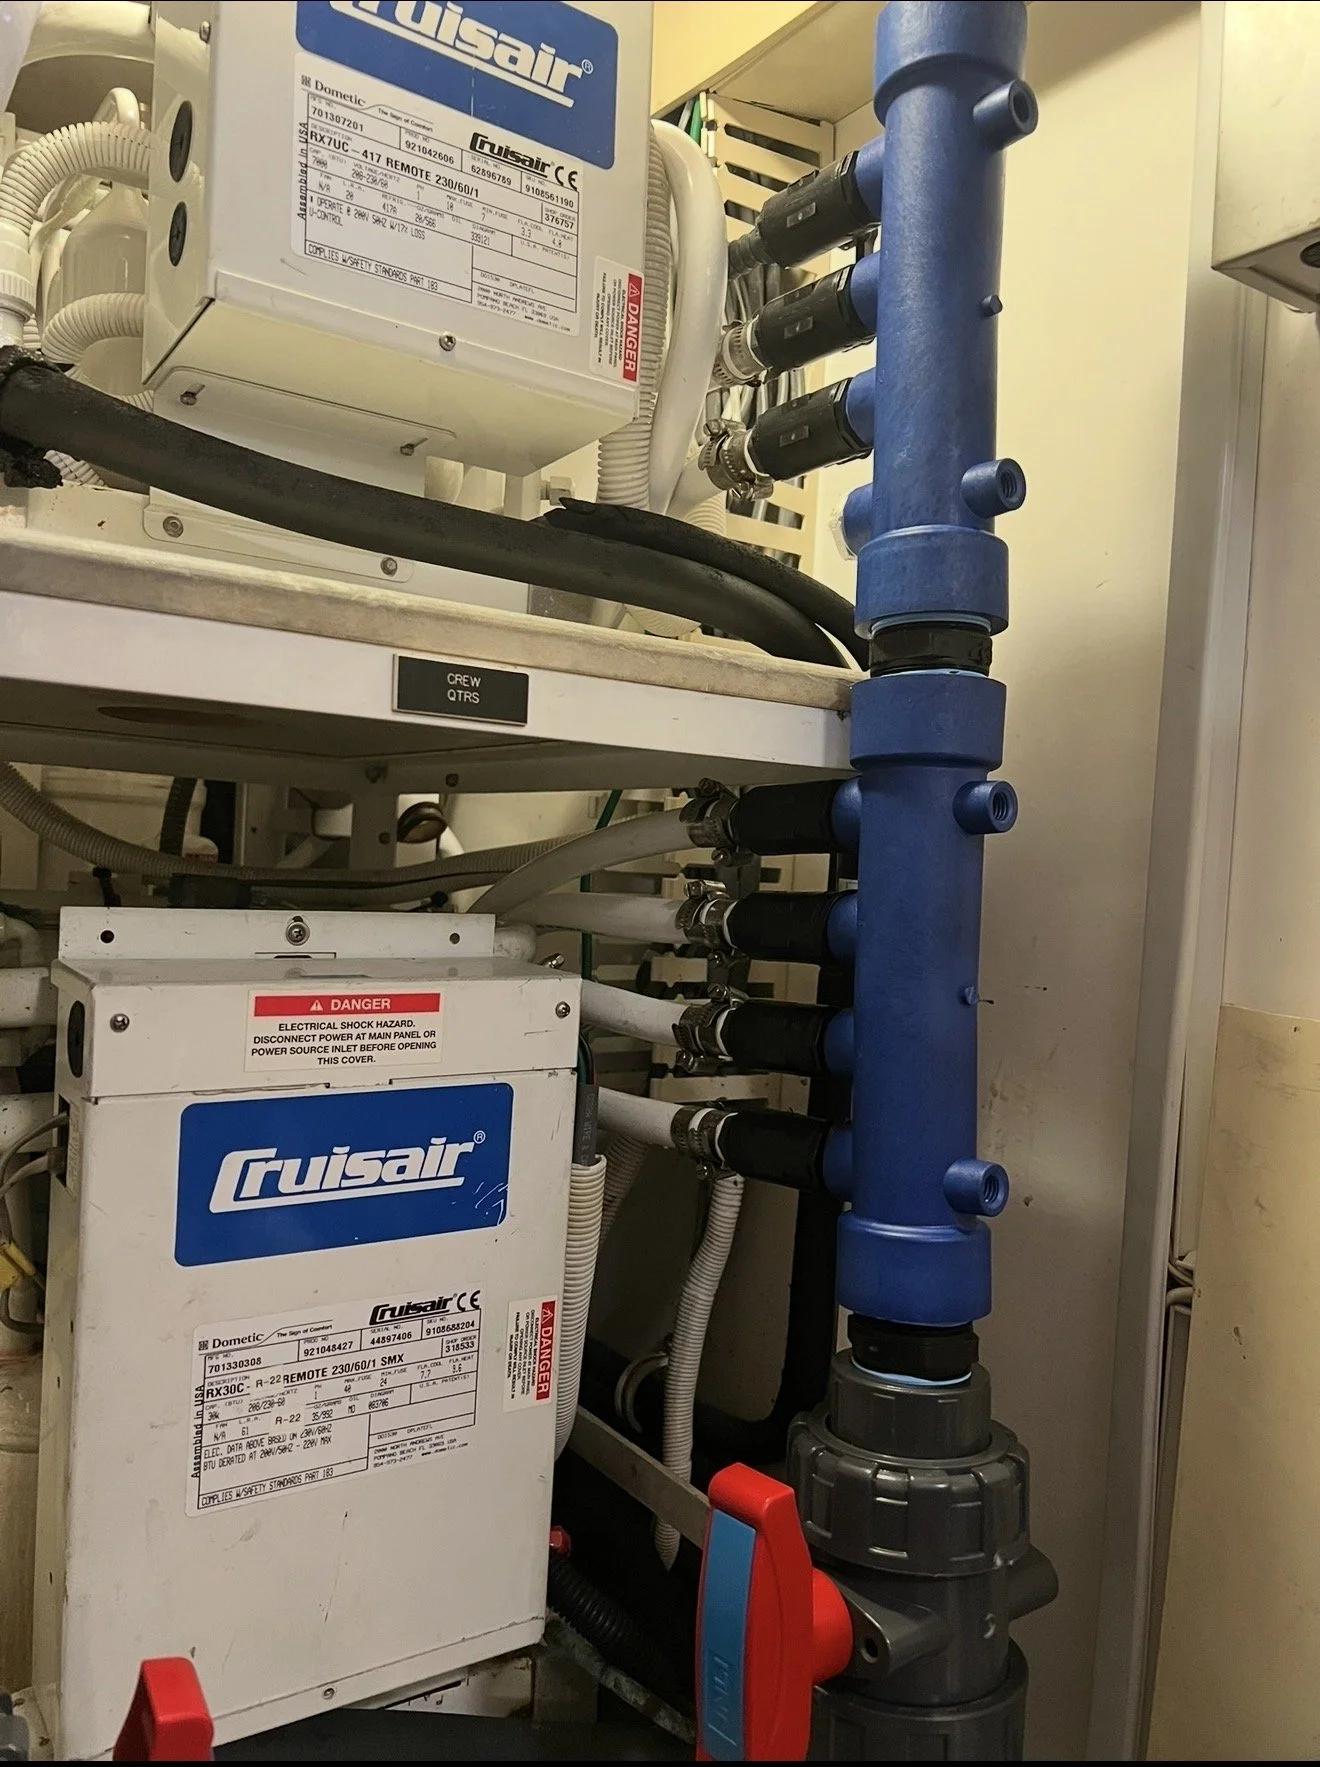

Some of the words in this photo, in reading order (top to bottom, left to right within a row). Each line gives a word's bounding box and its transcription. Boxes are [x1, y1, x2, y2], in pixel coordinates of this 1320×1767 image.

[315, 80, 366, 106] Dometic
[311, 106, 363, 132] 701307201
[298, 122, 308, 143] USA
[299, 148, 307, 157] in
[405, 140, 454, 165] 921042606
[469, 132, 551, 178] Cruisair
[386, 157, 431, 182] REMOTE
[435, 174, 478, 198] 230/60/1
[471, 165, 512, 186] 62896789
[525, 184, 574, 208] 9108561190
[309, 207, 343, 227] U-CONTROL
[316, 196, 343, 215] OPERATE
[411, 226, 426, 240] LOSS
[544, 213, 574, 230] 376757
[308, 243, 339, 261] COMPLIES
[342, 252, 373, 271] W/SAFETY
[374, 264, 407, 282] STANDARDS
[410, 274, 424, 286] PART
[427, 280, 438, 291] 183
[625, 303, 639, 372] DANGER
[447, 672, 481, 687] CREW
[447, 689, 480, 703] QTRS
[330, 998, 391, 1011] DANGER
[278, 1021, 338, 1032] ELECTRICAL
[340, 1020, 374, 1030] SHOCK
[375, 1019, 415, 1029] HAZARD.
[253, 1033, 316, 1044] DISCONNECT
[318, 1032, 353, 1042] POWER
[355, 1032, 367, 1041] AT
[368, 1031, 393, 1040] MAIN
[394, 1030, 421, 1039] PANEL
[423, 1030, 436, 1038] OR
[251, 1046, 287, 1056] POWER
[289, 1045, 329, 1055] SOURCE
[331, 1044, 358, 1053] INLET
[359, 1043, 395, 1052] BEFORE
[397, 1041, 437, 1051] OPENING
[317, 1056, 339, 1065] THIS
[341, 1055, 376, 1064] COVER.
[209, 1137, 475, 1214] Cruisair
[457, 1290, 480, 1312] CE
[369, 1296, 453, 1325] Cruisair
[309, 1324, 332, 1333] Comfort
[426, 1320, 475, 1336] 9108688204
[212, 1332, 264, 1349] Dometic
[370, 1332, 412, 1346] 44897406
[445, 1340, 475, 1353] 318533
[303, 1341, 353, 1356] 921048427
[208, 1357, 262, 1374] 701330308
[538, 1327, 553, 1393] DANGER
[255, 1375, 281, 1388] R-22
[282, 1367, 328, 1384] REMOTE
[331, 1358, 376, 1376] 230/60/1
[381, 1353, 404, 1367] SMX
[207, 1375, 250, 1387] DESCRIPTION
[195, 1384, 204, 1407] USA
[194, 1410, 203, 1419] in
[275, 1413, 301, 1425] R-22
[213, 1431, 226, 1442] N/A
[241, 1426, 249, 1436] 61
[191, 1424, 202, 1478] Assembled
[203, 1446, 223, 1459] ELEC.
[227, 1441, 243, 1454] DATA
[246, 1437, 264, 1450] ABOVE
[203, 1460, 216, 1471] BTU
[218, 1453, 246, 1468] DERATED
[249, 1452, 257, 1461] AT
[320, 1435, 332, 1446] MAX
[399, 1447, 416, 1455] BEACH
[201, 1491, 233, 1506] COMPLIES
[236, 1483, 266, 1498] W/SAFETY
[269, 1474, 302, 1490] STANDARDS
[304, 1470, 319, 1481] PART
[322, 1467, 334, 1478] 183
